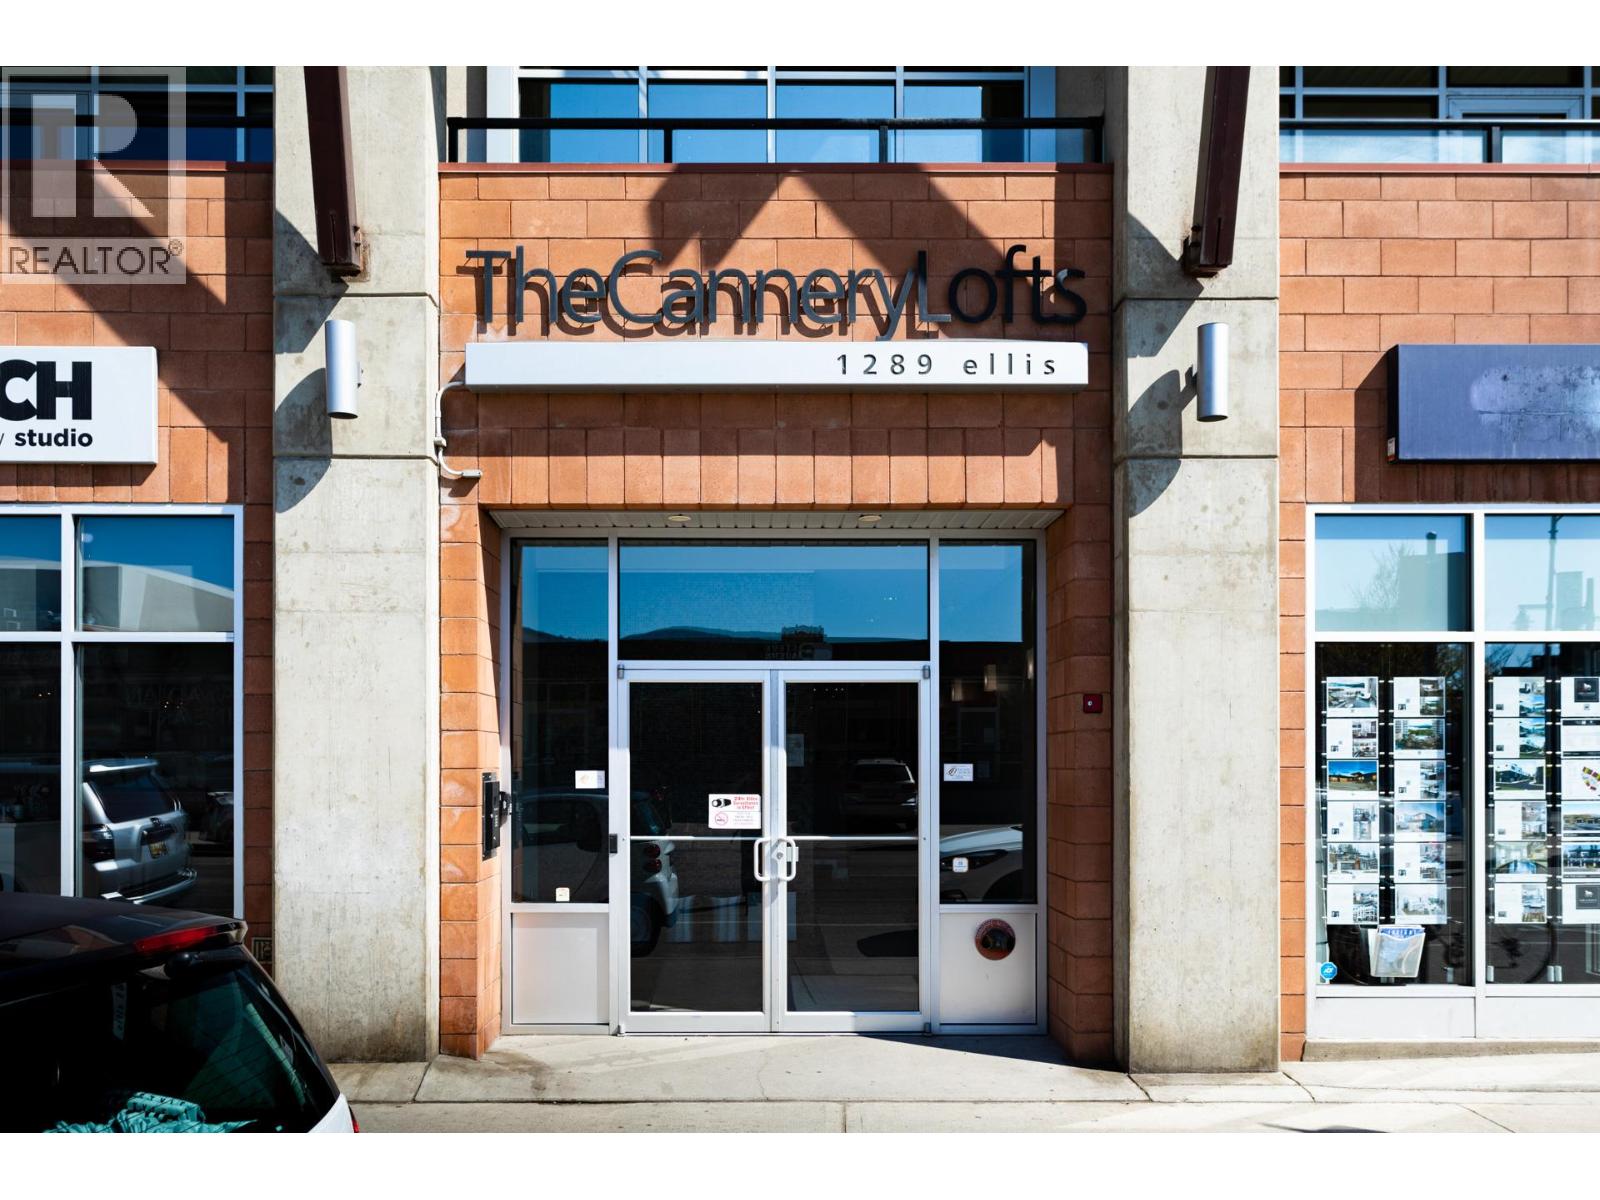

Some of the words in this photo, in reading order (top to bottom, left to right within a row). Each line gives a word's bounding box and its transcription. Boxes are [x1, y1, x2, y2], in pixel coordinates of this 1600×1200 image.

[466, 244, 1087, 341] TheCanneryLofts
[837, 354, 933, 375] 1289
[963, 353, 1056, 375] ellis
[15, 428, 93, 447] studio
